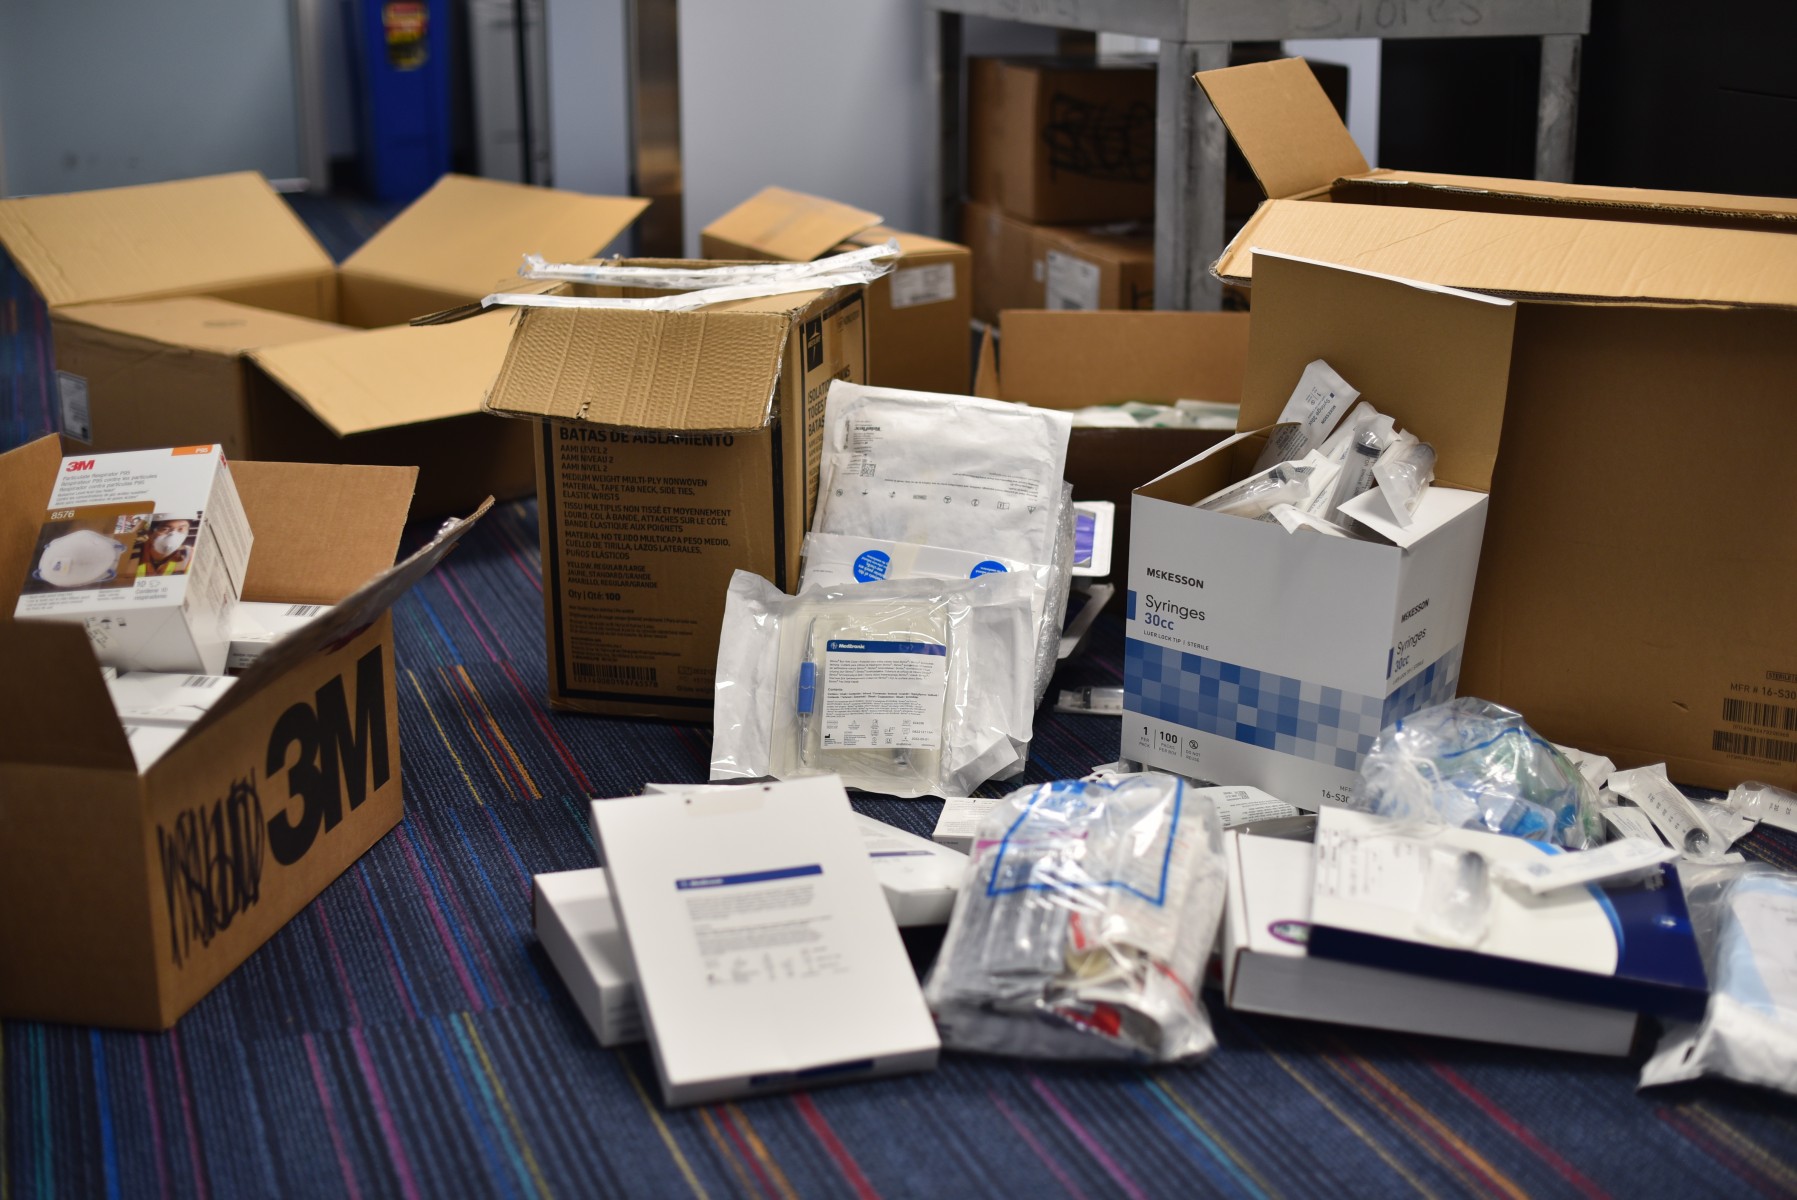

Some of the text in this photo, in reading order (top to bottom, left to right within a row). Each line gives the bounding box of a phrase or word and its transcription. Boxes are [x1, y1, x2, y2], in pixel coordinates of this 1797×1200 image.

[560, 426, 607, 442] BATAS
[610, 431, 630, 444] DE
[580, 455, 608, 463] NIVEAU
[66, 460, 95, 472] 3M
[51, 510, 75, 520] 8576
[605, 593, 621, 601] 100
[1145, 594, 1205, 620] Syringes
[1144, 612, 1174, 630] 30cc
[1144, 630, 1158, 638] LUER
[1396, 628, 1427, 656] Syringes
[1730, 682, 1750, 693] MFR
[1143, 726, 1148, 736] 1
[1160, 731, 1177, 744] 100
[266, 643, 390, 867] 3M
